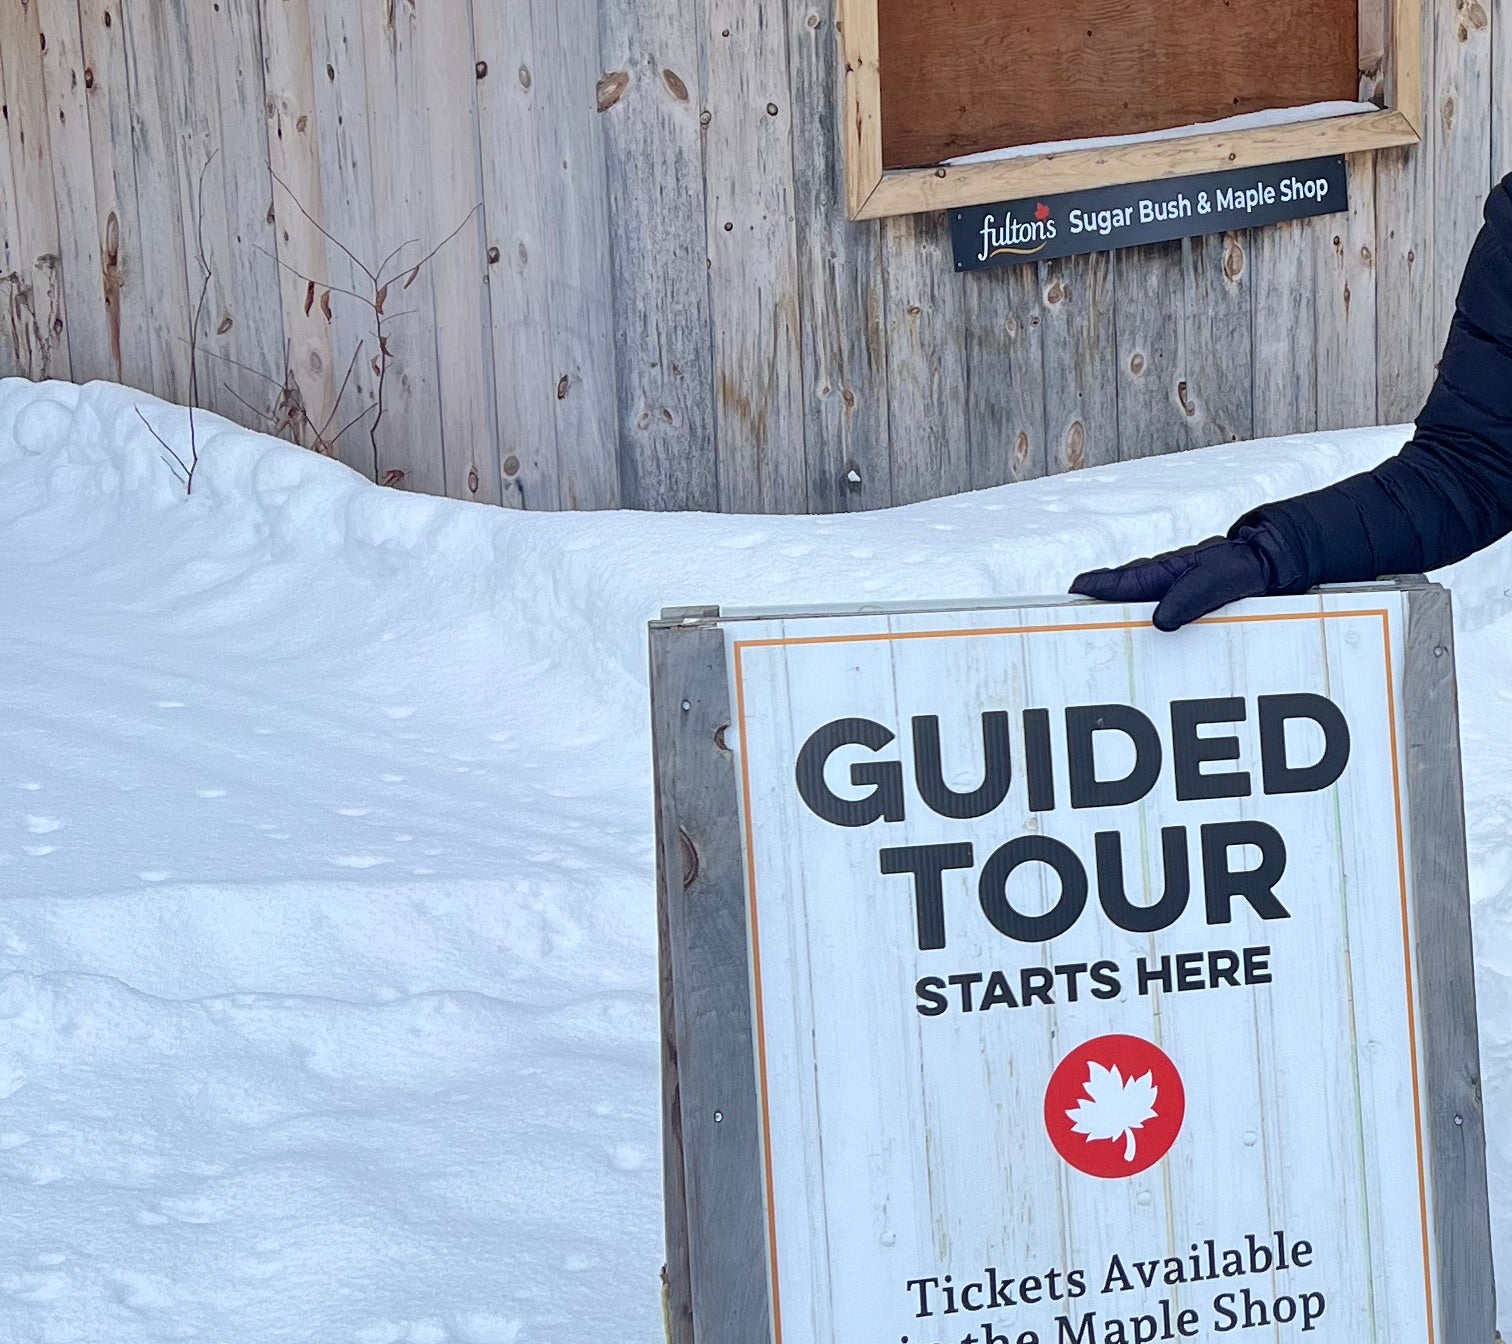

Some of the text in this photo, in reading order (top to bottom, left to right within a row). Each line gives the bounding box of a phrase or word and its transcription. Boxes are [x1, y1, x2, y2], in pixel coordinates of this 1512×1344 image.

[1069, 206, 1133, 235] Sugar
[1139, 194, 1192, 224] Bush
[1197, 191, 1212, 215] &
[1216, 182, 1276, 213] Maple
[1279, 176, 1328, 202] Shop
[795, 692, 1351, 827] GUIDED
[879, 820, 1291, 950] TOUR
[916, 946, 1273, 1017] STARTS HERE
[906, 1230, 1314, 1318] Tickets Available
[1213, 1287, 1326, 1331] Shop
